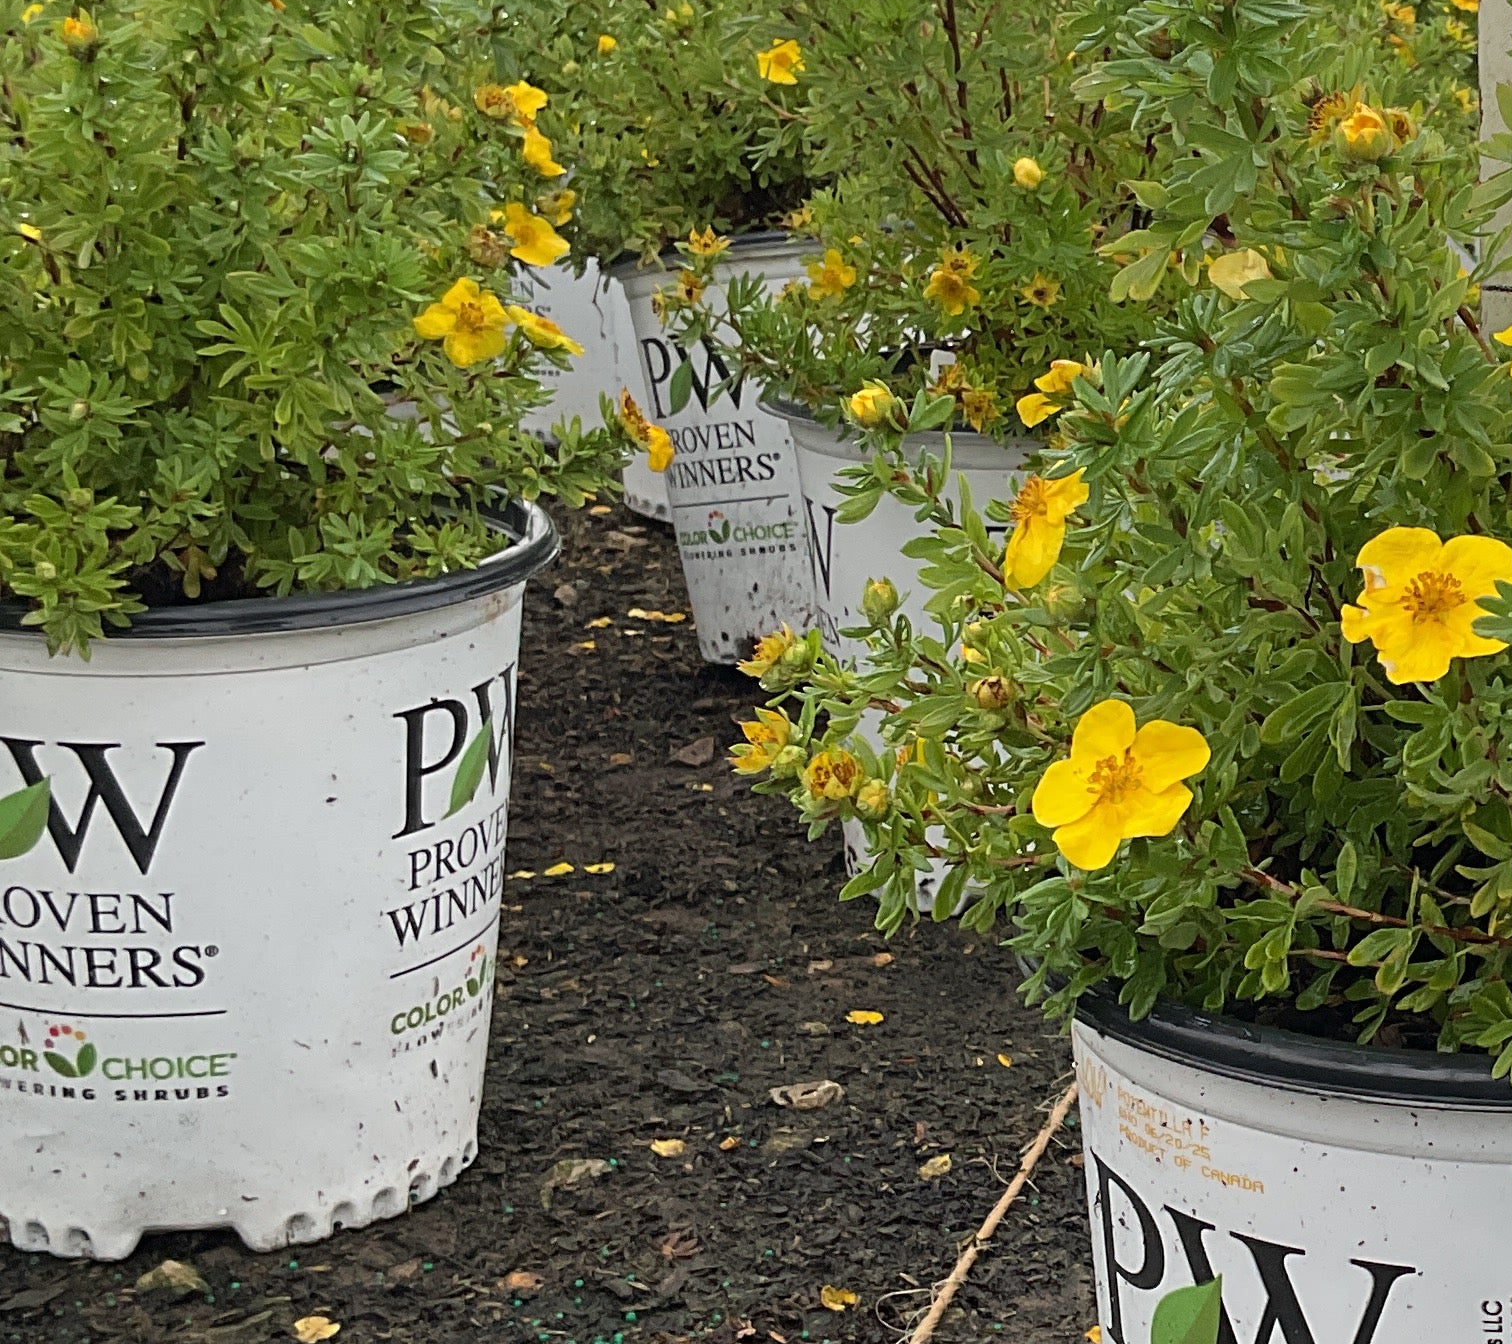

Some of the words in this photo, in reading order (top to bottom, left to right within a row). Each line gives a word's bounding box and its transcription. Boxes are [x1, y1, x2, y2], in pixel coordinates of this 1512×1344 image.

[669, 420, 756, 455] ROVEN
[0, 736, 206, 877] W
[0, 885, 176, 935] OVEN
[386, 848, 505, 947] WINNE
[0, 937, 220, 989] NNERS®
[390, 986, 465, 1037] COLOR
[0, 1077, 97, 1101] WERING
[114, 1084, 230, 1102] SHRUBS
[1119, 1124, 1166, 1160] PRODUCT
[1173, 1155, 1192, 1173] OF
[1201, 1165, 1265, 1195] CANADA
[1481, 1299, 1503, 1333] LLC
